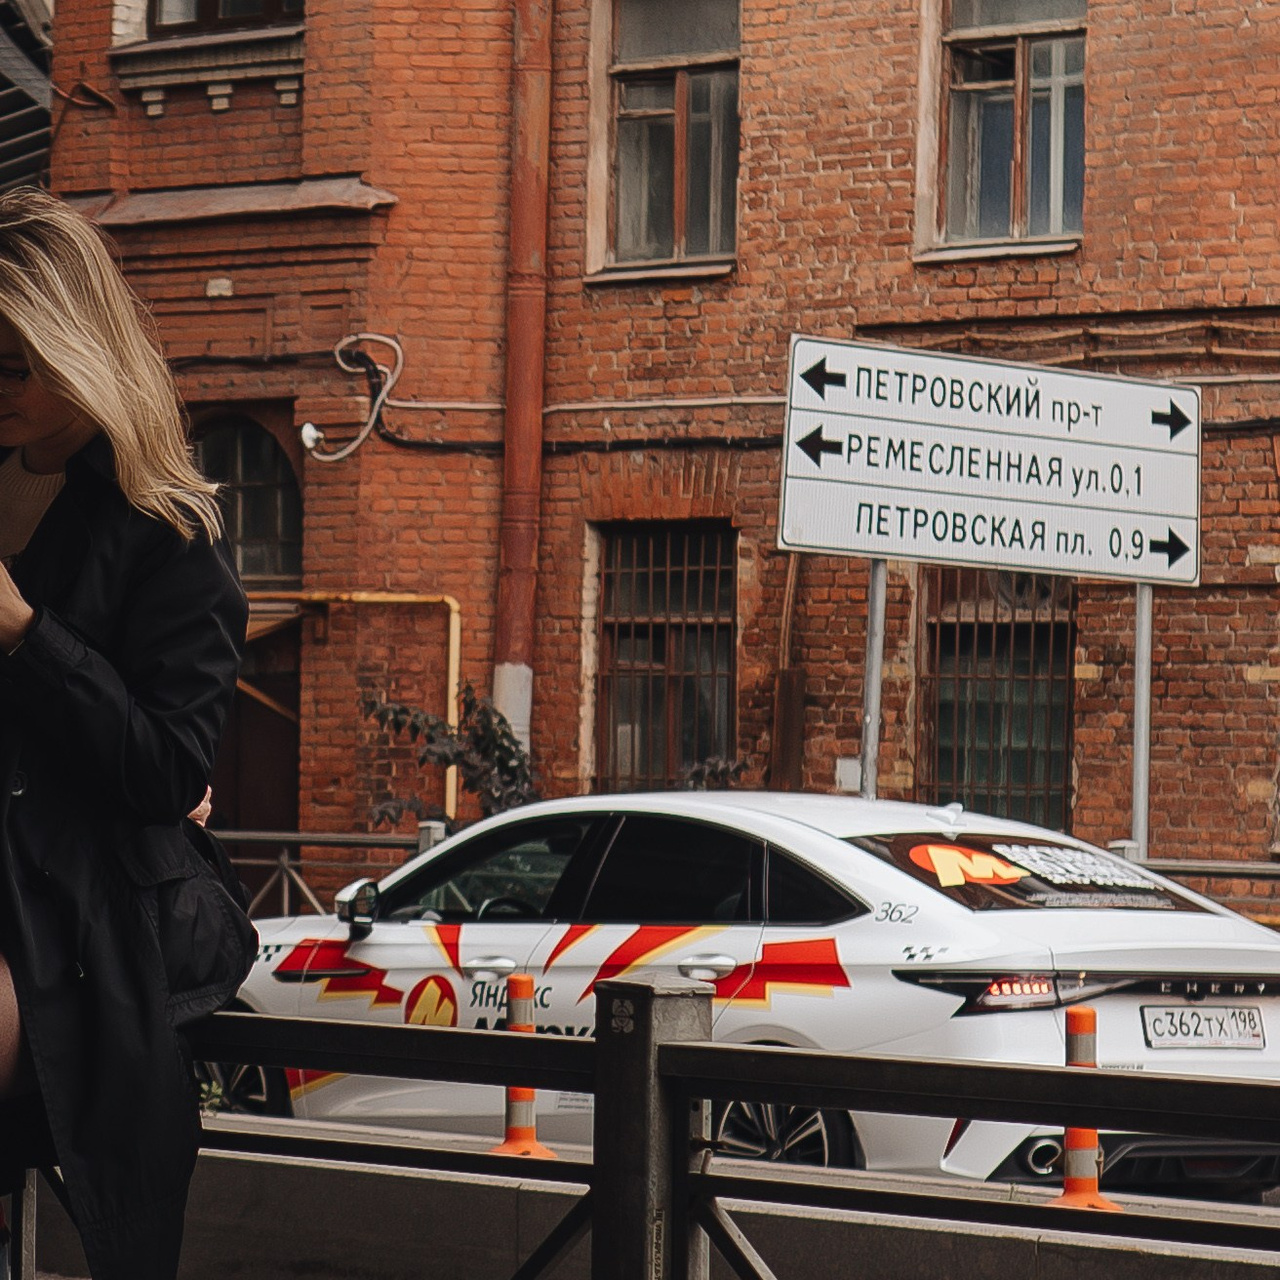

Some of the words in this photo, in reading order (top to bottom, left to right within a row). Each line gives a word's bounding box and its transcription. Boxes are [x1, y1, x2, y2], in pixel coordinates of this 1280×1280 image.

[855, 366, 1040, 419] ПЕТРОВСКИЙ
[1051, 399, 1102, 431] пр-т
[847, 433, 1062, 488] РЕМЕСЛЕННАЯ
[856, 503, 1046, 552] ПЕТРОВСКАЯ
[1056, 528, 1092, 556] пл.
[1109, 527, 1145, 561] 0,9
[875, 901, 919, 924] 362
